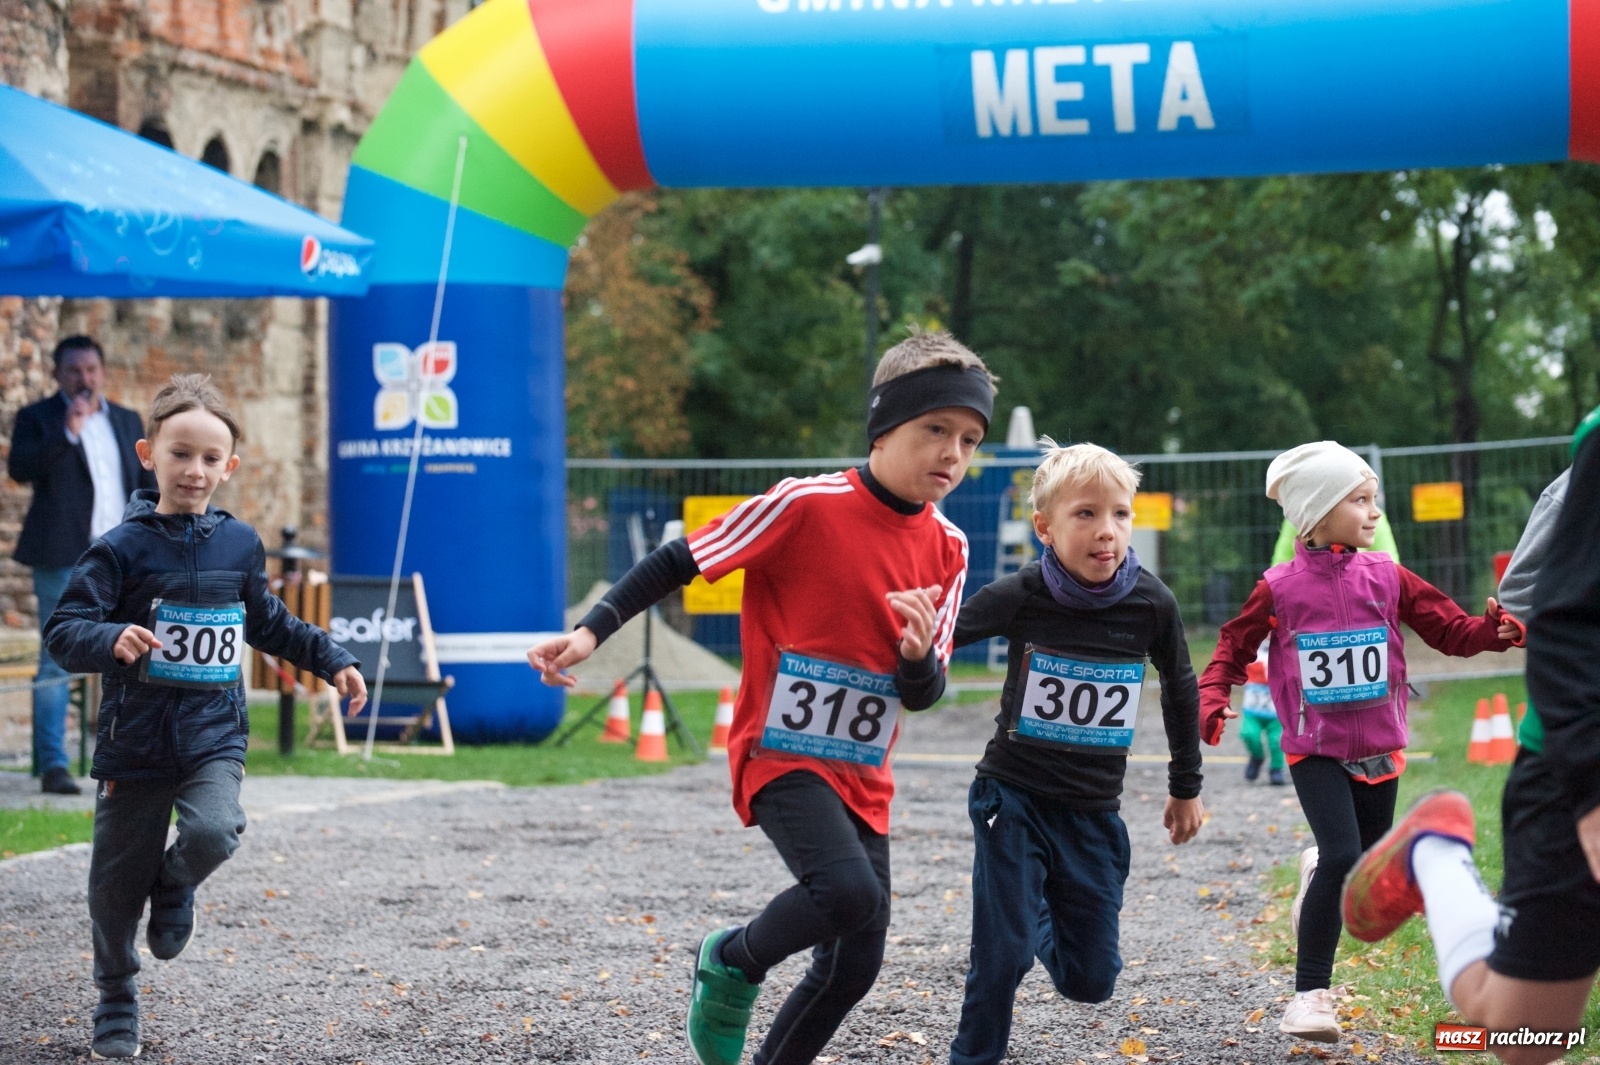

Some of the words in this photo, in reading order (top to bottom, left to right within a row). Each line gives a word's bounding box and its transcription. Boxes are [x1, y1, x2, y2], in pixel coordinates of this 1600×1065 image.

[969, 41, 1216, 138] META
[162, 625, 236, 665] 308
[1300, 632, 1384, 647] TIME-SPORT.PL
[1035, 658, 1139, 679] TIME-SPORT.PL
[1308, 646, 1380, 687] 310
[781, 681, 887, 742] 318
[1034, 677, 1130, 727] 302
[842, 741, 853, 749] NA
[1025, 719, 1054, 730] NUMER
[1055, 725, 1094, 736] ZWROTNY
